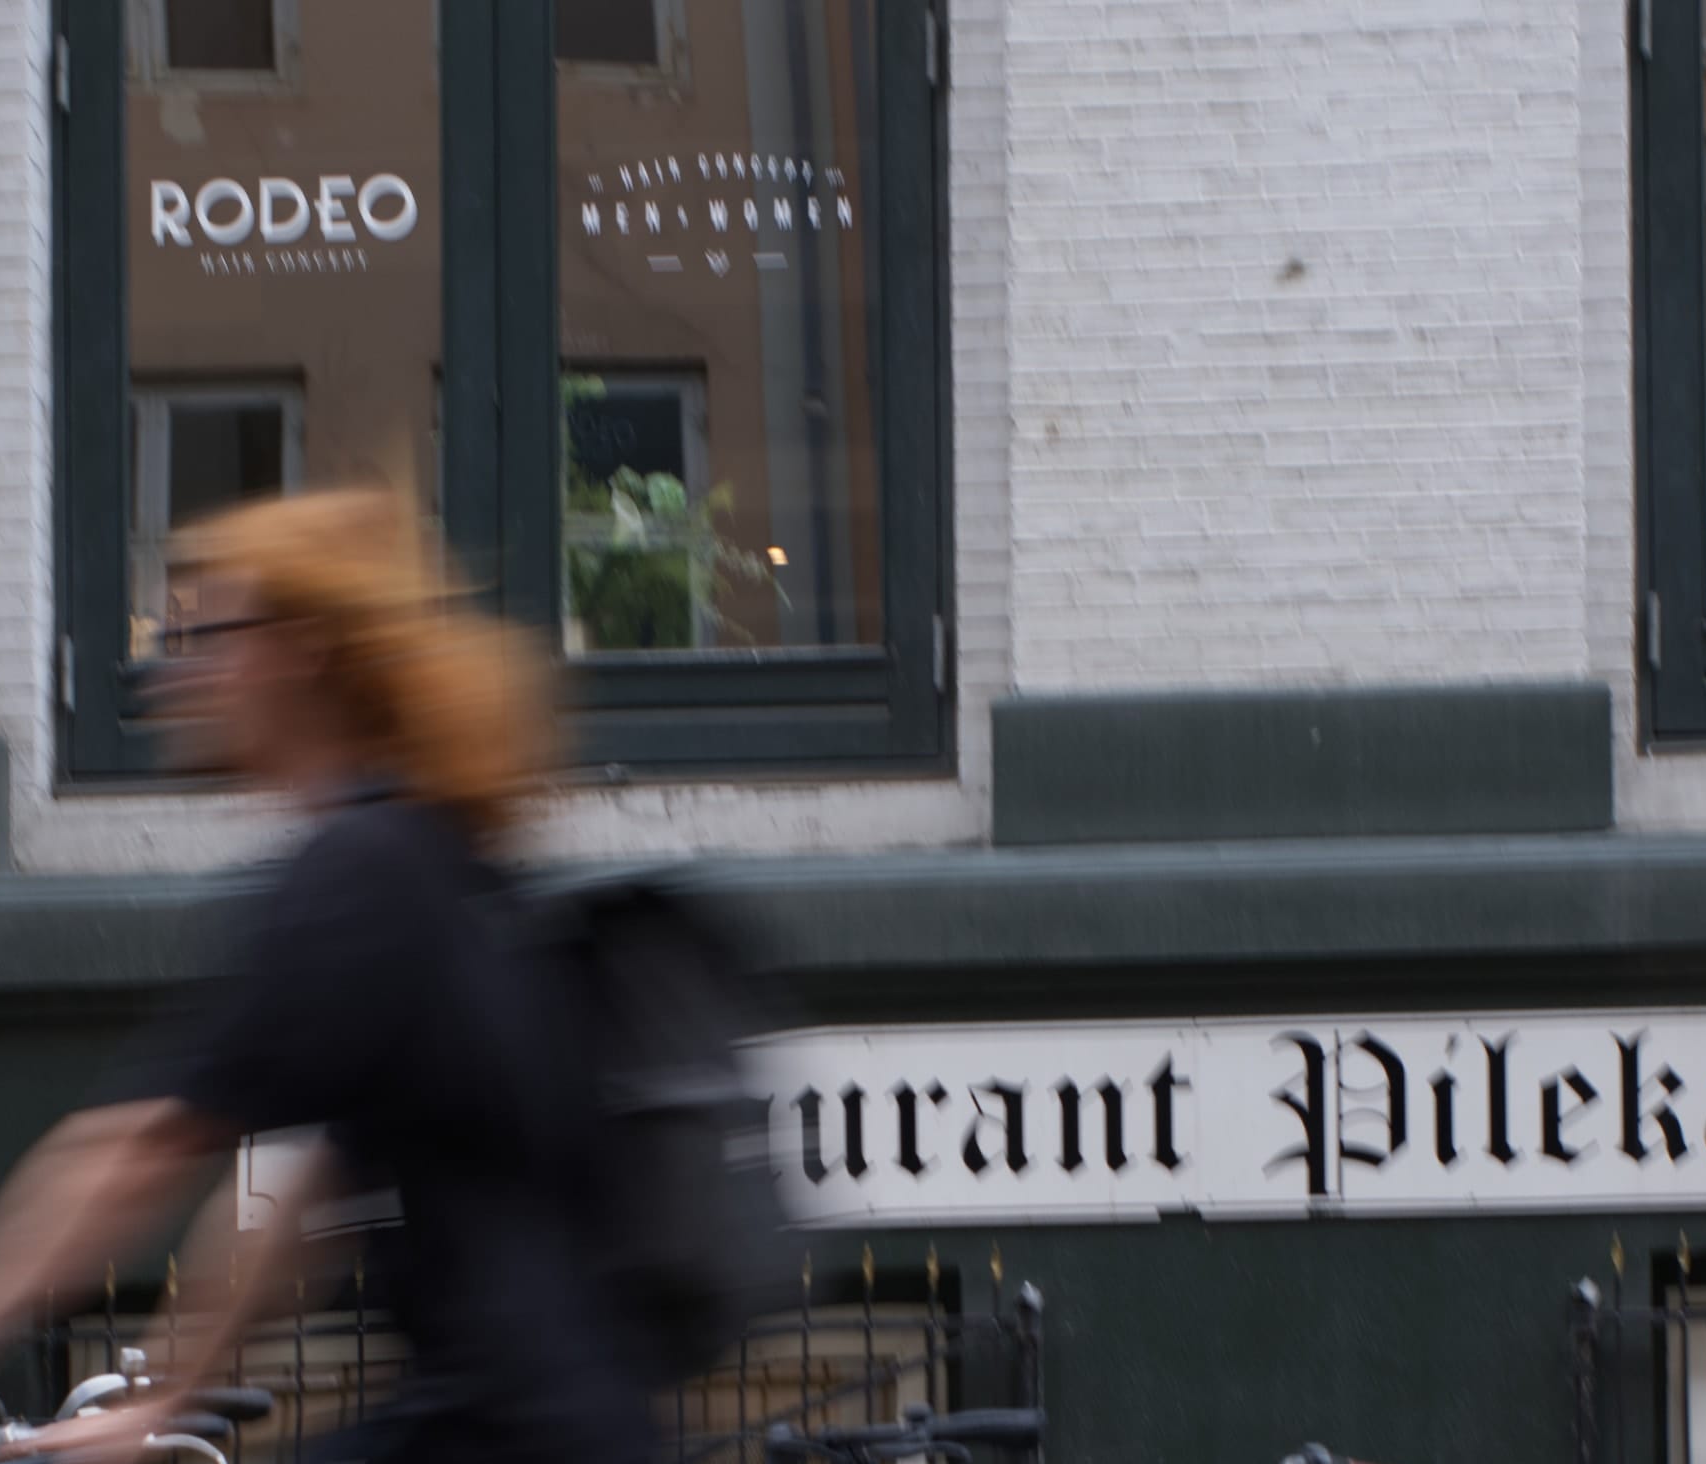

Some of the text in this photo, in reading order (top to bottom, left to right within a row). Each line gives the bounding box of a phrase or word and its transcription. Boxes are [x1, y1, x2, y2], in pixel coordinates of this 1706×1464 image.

[150, 173, 419, 248] RODEO
[581, 201, 661, 235] MEN
[708, 195, 853, 233] WOMEN
[769, 1050, 1192, 1186] urant
